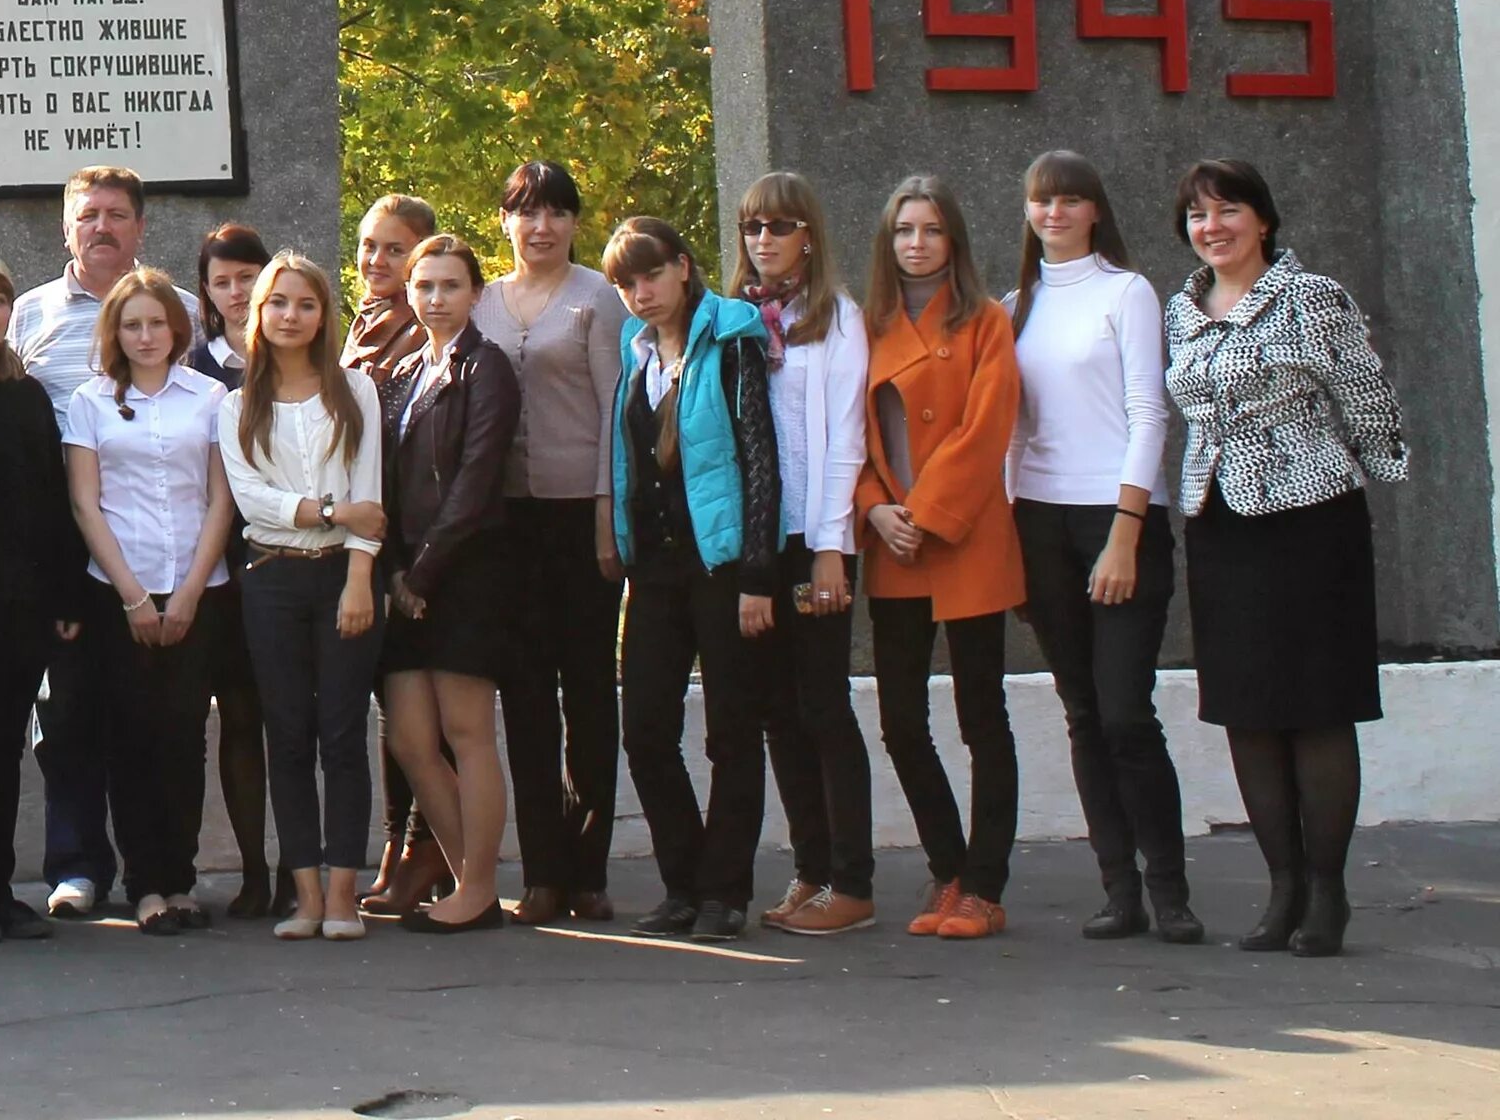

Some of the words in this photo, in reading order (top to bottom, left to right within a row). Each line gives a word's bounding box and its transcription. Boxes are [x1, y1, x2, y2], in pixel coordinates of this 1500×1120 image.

[98, 18, 187, 42] ЖИВШИЕ
[50, 53, 213, 78] СОКРУШИВШИЕ,
[46, 92, 58, 114] О
[72, 90, 111, 114] ВАС
[124, 89, 214, 113] НИКОГДА
[24, 128, 50, 151] НЕ
[64, 120, 142, 151] УМРЁТ!
